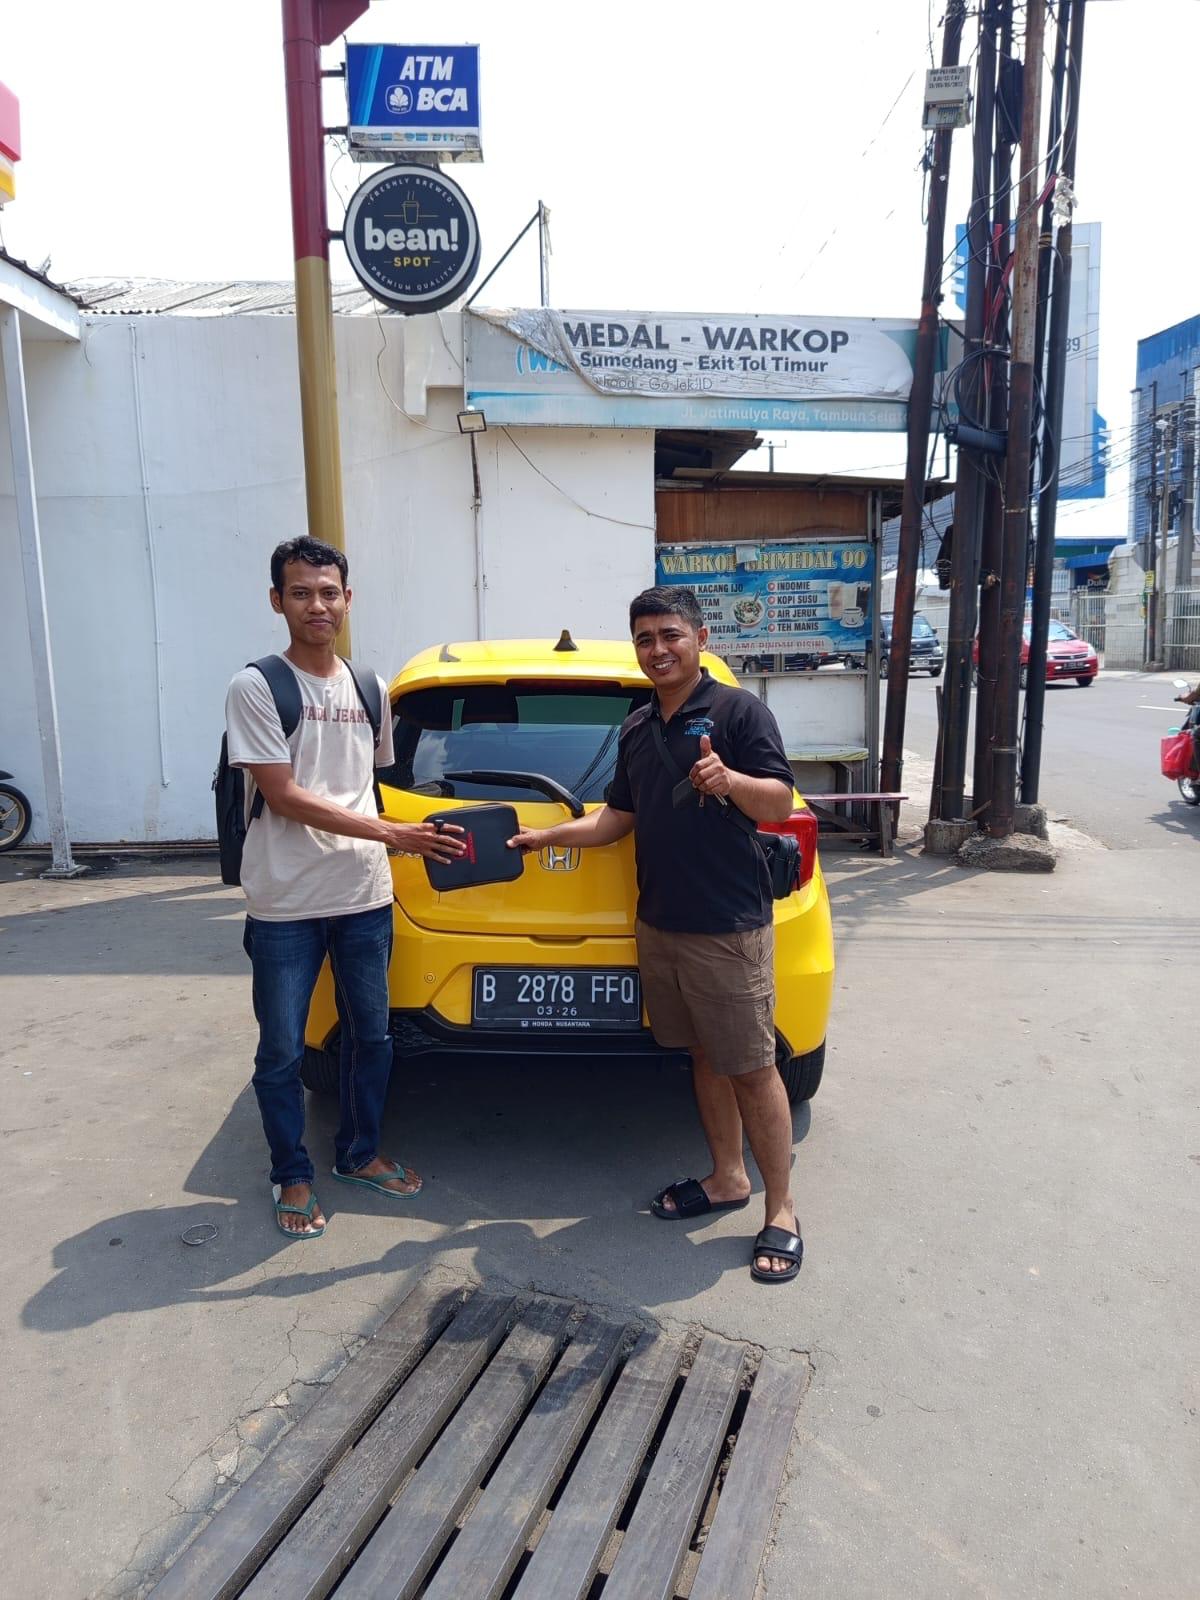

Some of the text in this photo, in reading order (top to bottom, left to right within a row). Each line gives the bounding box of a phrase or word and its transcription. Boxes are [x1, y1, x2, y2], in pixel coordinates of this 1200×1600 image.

[399, 56, 454, 81] ATM
[416, 87, 469, 112] BCA
[368, 178, 453, 203] FRESHLY BREWED
[363, 217, 459, 252] bean!
[393, 256, 431, 268] SPOT
[370, 265, 455, 292] PREMIUM QUALITY
[563, 321, 670, 350] MEDAL
[702, 326, 849, 354] WARKOP
[580, 350, 678, 374] Sumedang
[698, 355, 735, 372] Exit
[738, 356, 767, 372] Tol
[773, 356, 829, 373] Timur
[701, 406, 769, 422] Jatimulya
[813, 408, 865, 422] Tambun
[842, 549, 867, 570] 90
[698, 584, 729, 593] KACANG
[731, 583, 744, 593] IJO
[777, 581, 811, 591] INDOMIE
[700, 598, 720, 608] ITAM
[777, 594, 818, 605] KOPI SUSU
[777, 608, 817, 619] AIR JERUK
[710, 624, 742, 634] MATANG
[777, 622, 819, 632] TEH MANIS
[482, 974, 634, 1004] B 2878 FFQ
